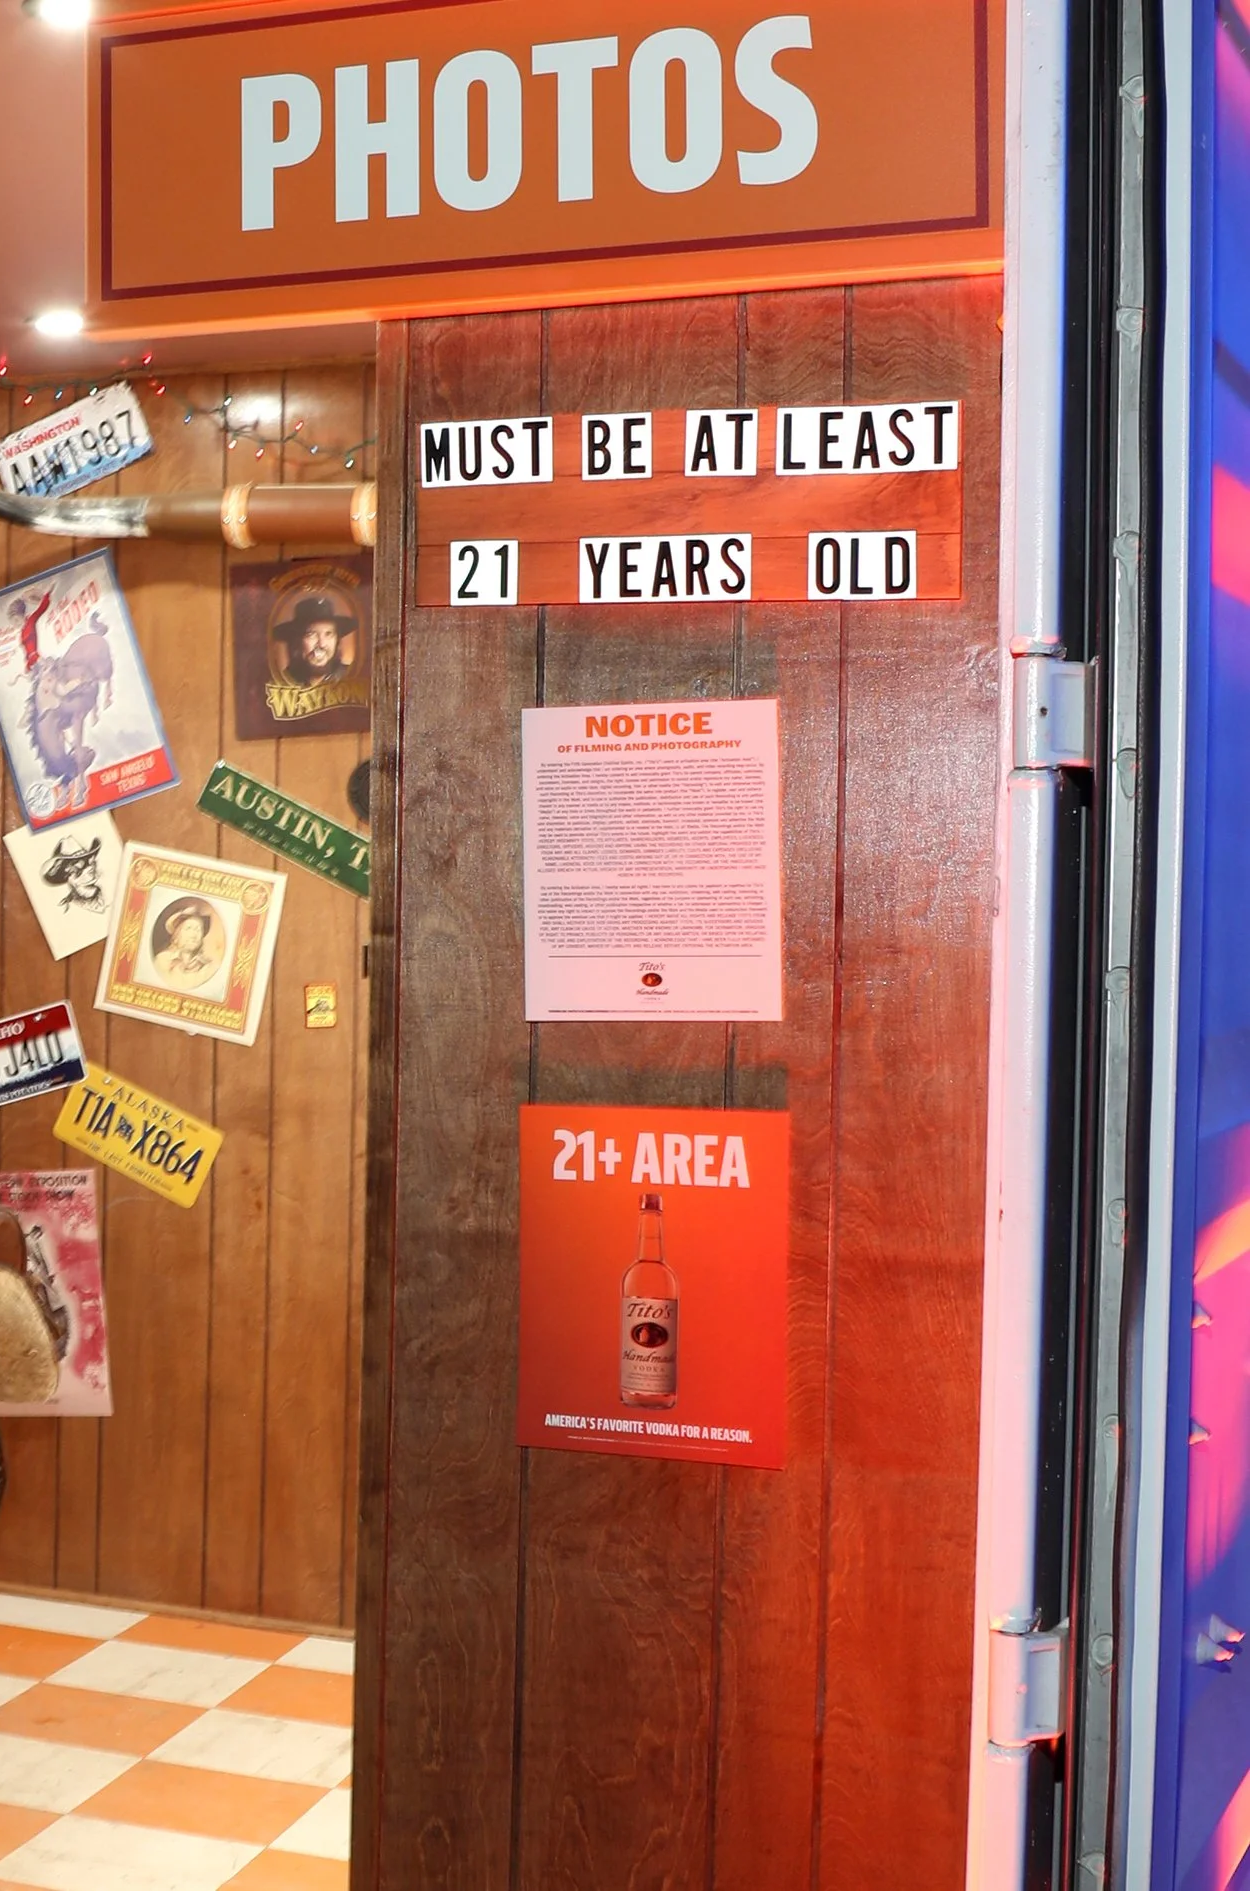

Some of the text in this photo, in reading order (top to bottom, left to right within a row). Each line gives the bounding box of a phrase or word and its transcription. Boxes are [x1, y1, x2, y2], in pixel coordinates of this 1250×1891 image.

[241, 15, 819, 232] PHOTOS
[4, 411, 81, 460] WASHINGTON
[425, 406, 953, 482] MUST BE AT LEAST
[457, 535, 910, 599] 21 YEARS OLD
[557, 740, 742, 754] OF FILMING AND PHOTOGRAPHY
[585, 712, 713, 738] NOTICE
[209, 774, 336, 859] AUSTIN,
[639, 961, 666, 972] Tito's
[112, 1086, 184, 1133] ALASKA
[128, 1119, 205, 1186] X864
[553, 1128, 750, 1188] 21+ AREA
[627, 1302, 672, 1319] Tito's
[545, 1413, 596, 1430] AMERICA'S
[597, 1418, 644, 1434] FAVORITE
[646, 1422, 679, 1437] VODKA
[681, 1427, 700, 1439] FOR
[701, 1429, 709, 1440] A
[710, 1428, 753, 1444] REASON.
